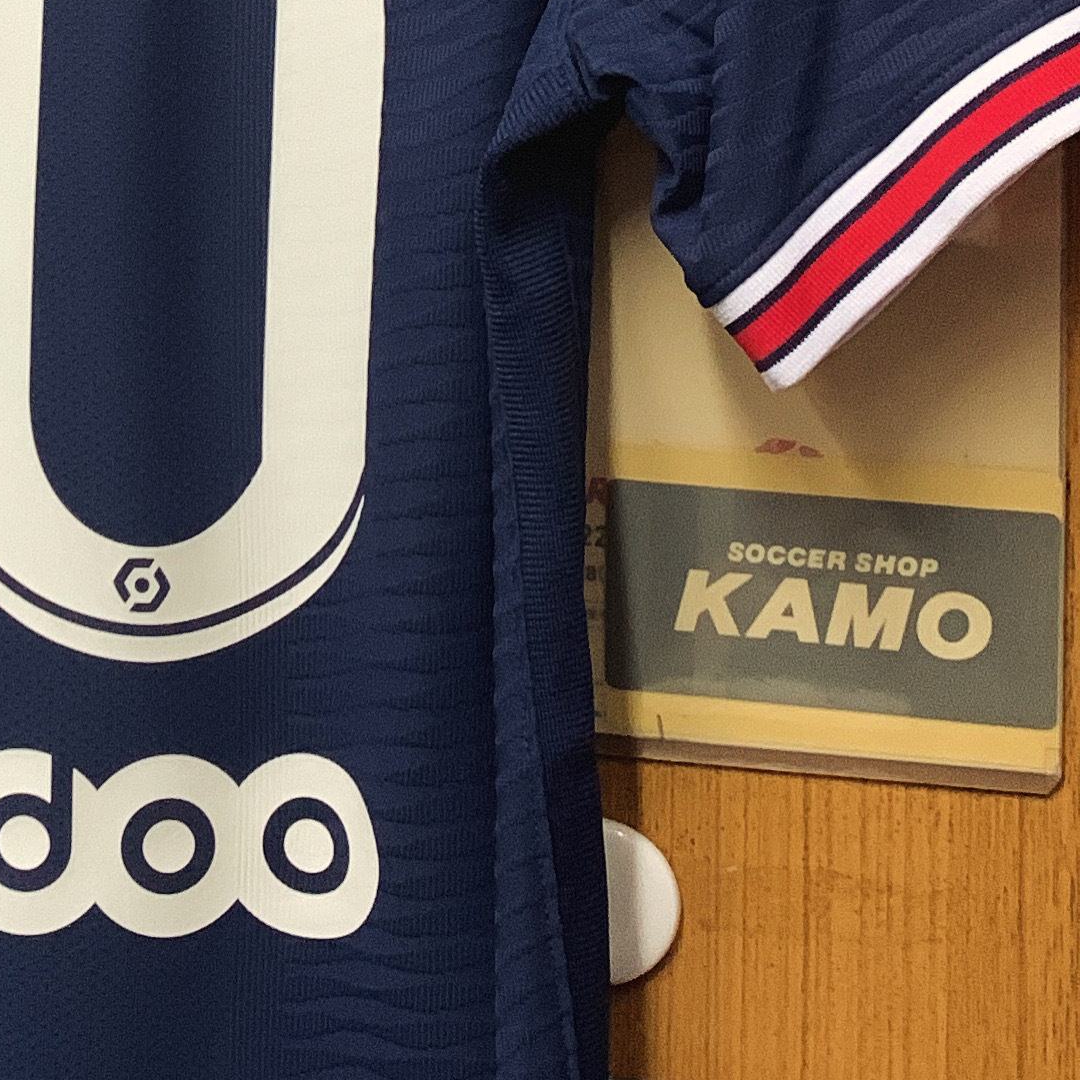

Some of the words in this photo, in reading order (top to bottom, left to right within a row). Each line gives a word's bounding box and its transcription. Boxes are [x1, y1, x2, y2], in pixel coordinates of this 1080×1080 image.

[727, 541, 847, 571] SOCCER
[854, 552, 939, 578] SHOP
[673, 569, 993, 660] KAMO
